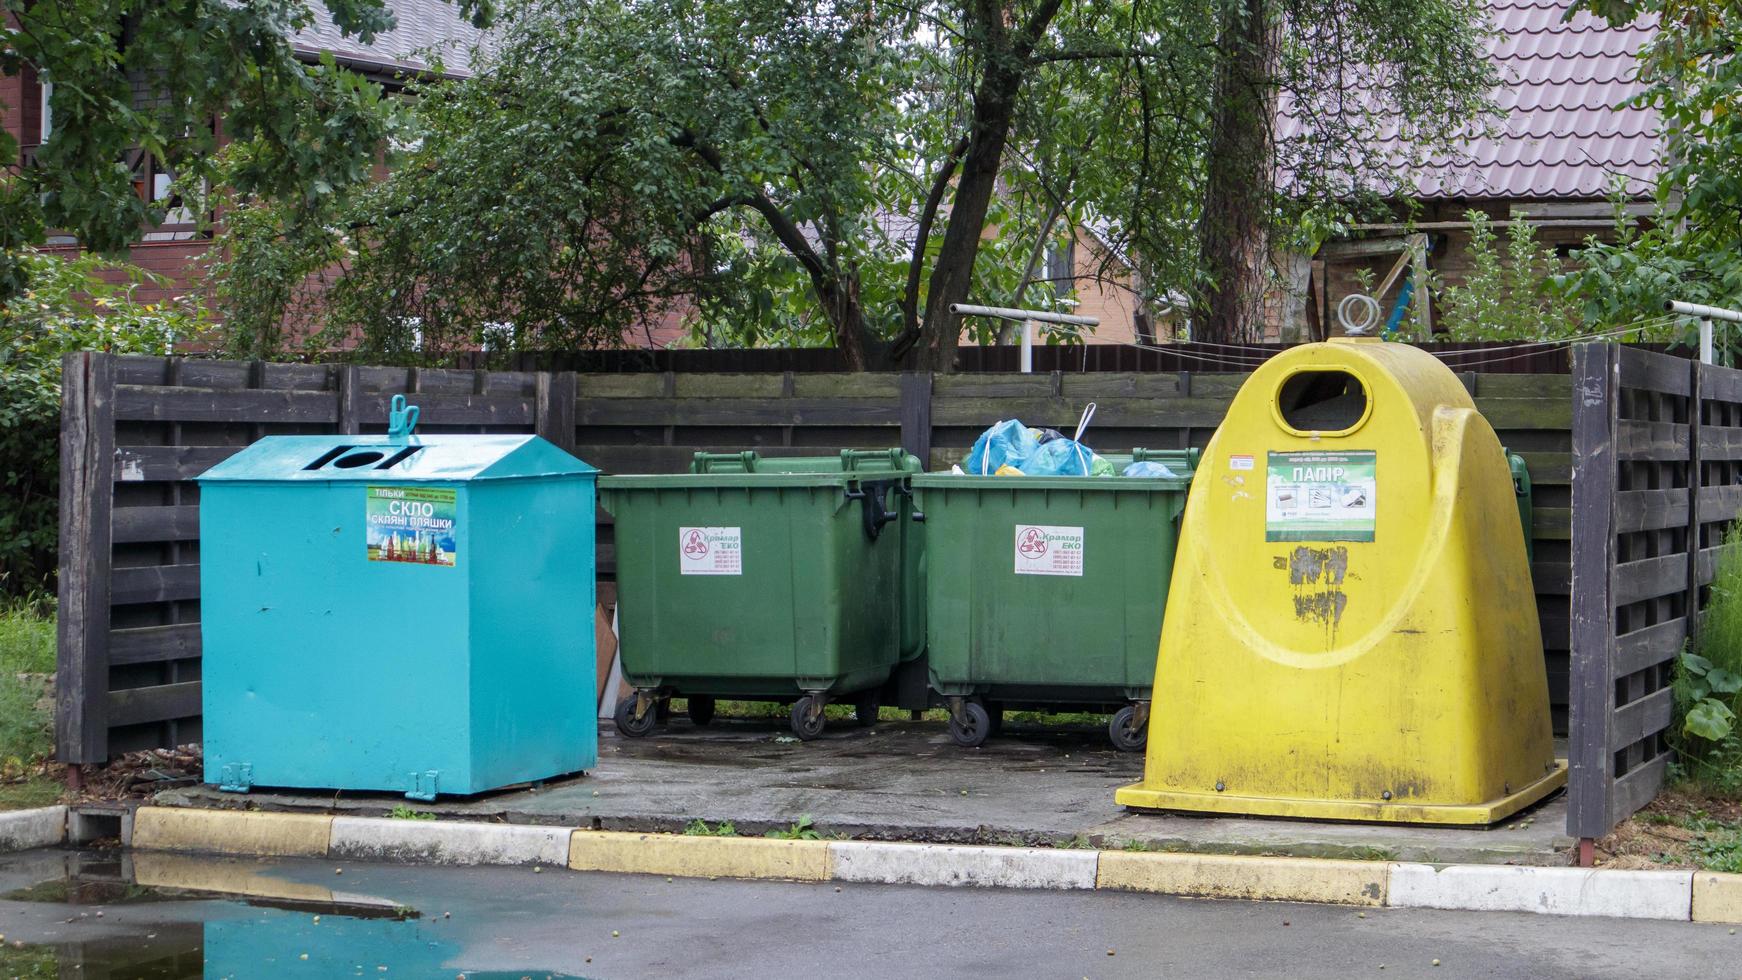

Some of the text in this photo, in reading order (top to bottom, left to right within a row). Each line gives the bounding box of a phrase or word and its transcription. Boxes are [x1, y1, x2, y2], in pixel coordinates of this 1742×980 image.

[1292, 466, 1345, 483] ПАПІР
[375, 488, 405, 499] ТІЛЬКИ
[389, 500, 434, 517] СКЛО
[371, 514, 408, 527] СКЛЯНІ
[409, 516, 452, 529] ПЛЯШКИ
[721, 542, 739, 550] ЕКО
[1062, 542, 1081, 550] ЕКО
